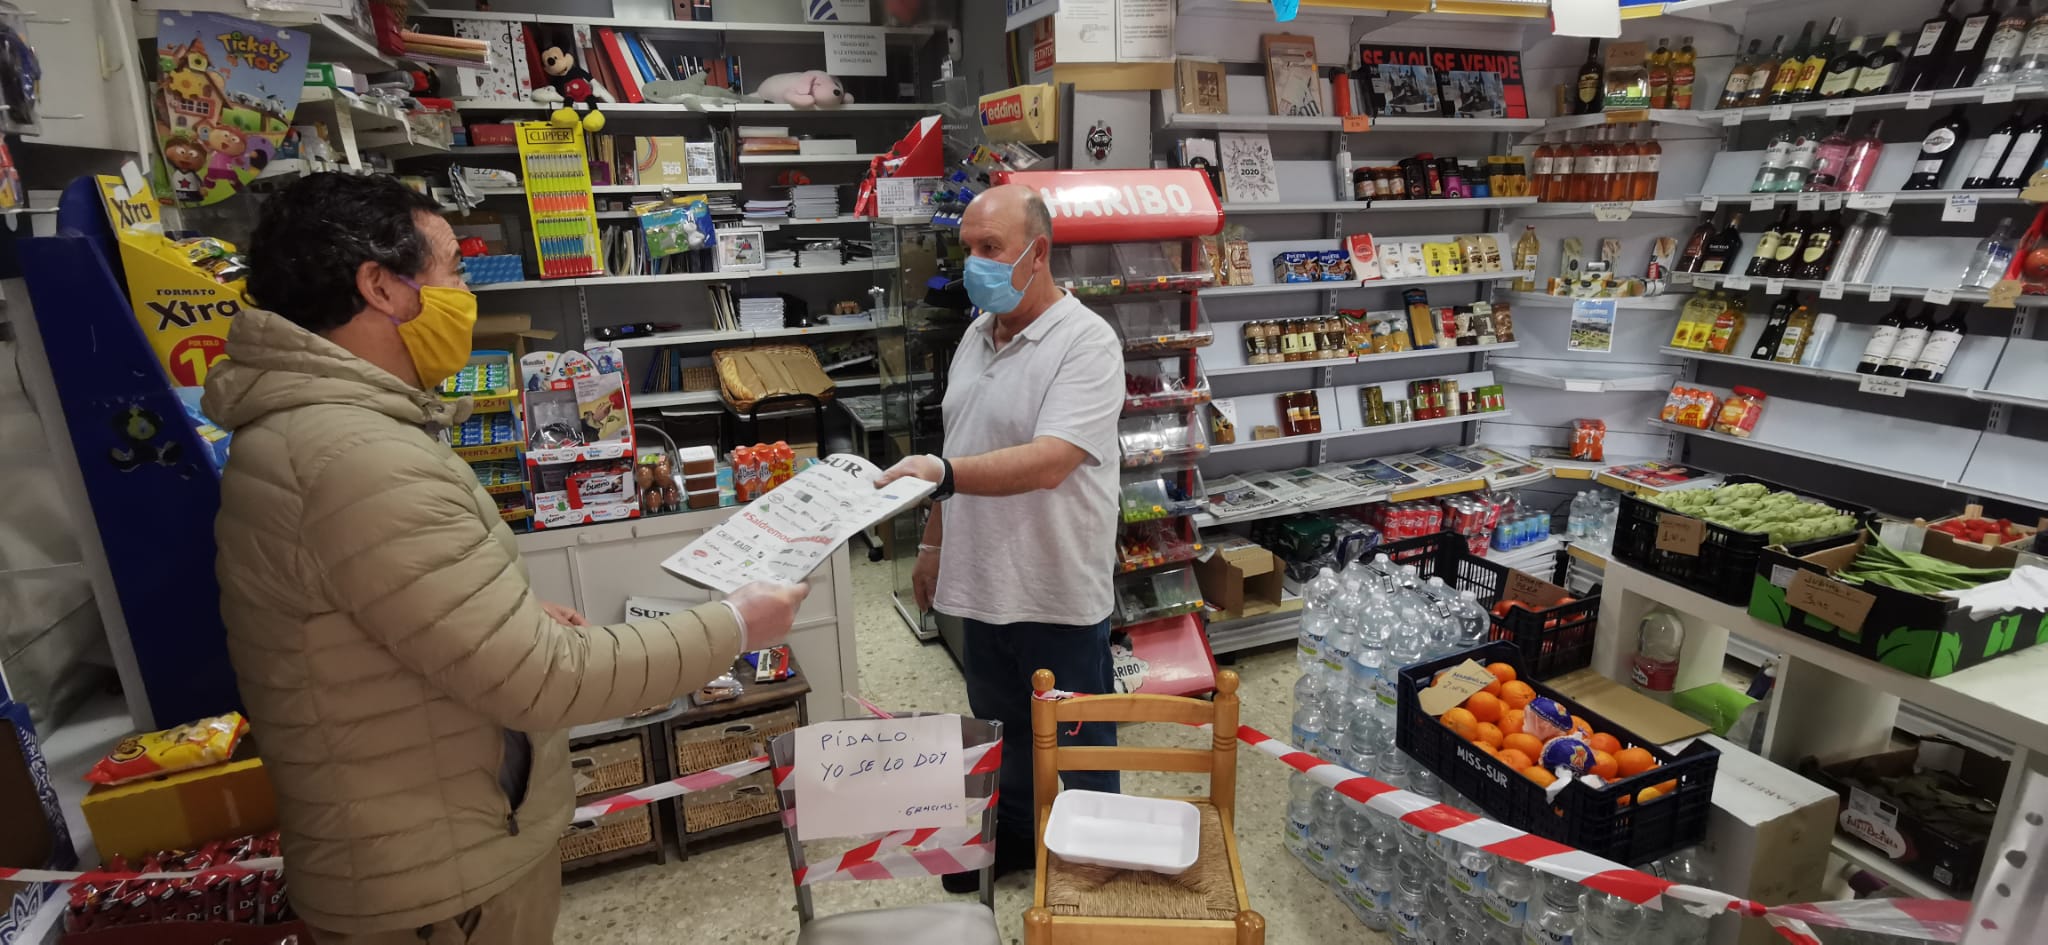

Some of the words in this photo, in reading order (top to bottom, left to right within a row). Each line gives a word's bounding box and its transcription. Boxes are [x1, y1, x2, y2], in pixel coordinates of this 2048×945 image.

[217, 31, 292, 63] Tickety
[1433, 52, 1456, 72] SE
[1460, 54, 1521, 80] VENDE
[987, 101, 1022, 121] edding
[529, 131, 570, 141] CLIPPER
[111, 197, 152, 229] Xtra
[1040, 184, 1193, 218] HARIBO
[145, 300, 241, 331] Xtra
[586, 480, 610, 492] bueno
[1113, 663, 1140, 681] ARIBO
[821, 762, 844, 782] YO
[850, 759, 876, 777] SE
[883, 757, 904, 772] LO
[913, 751, 948, 769] DOY
[1456, 745, 1509, 789] MISS-SUR
